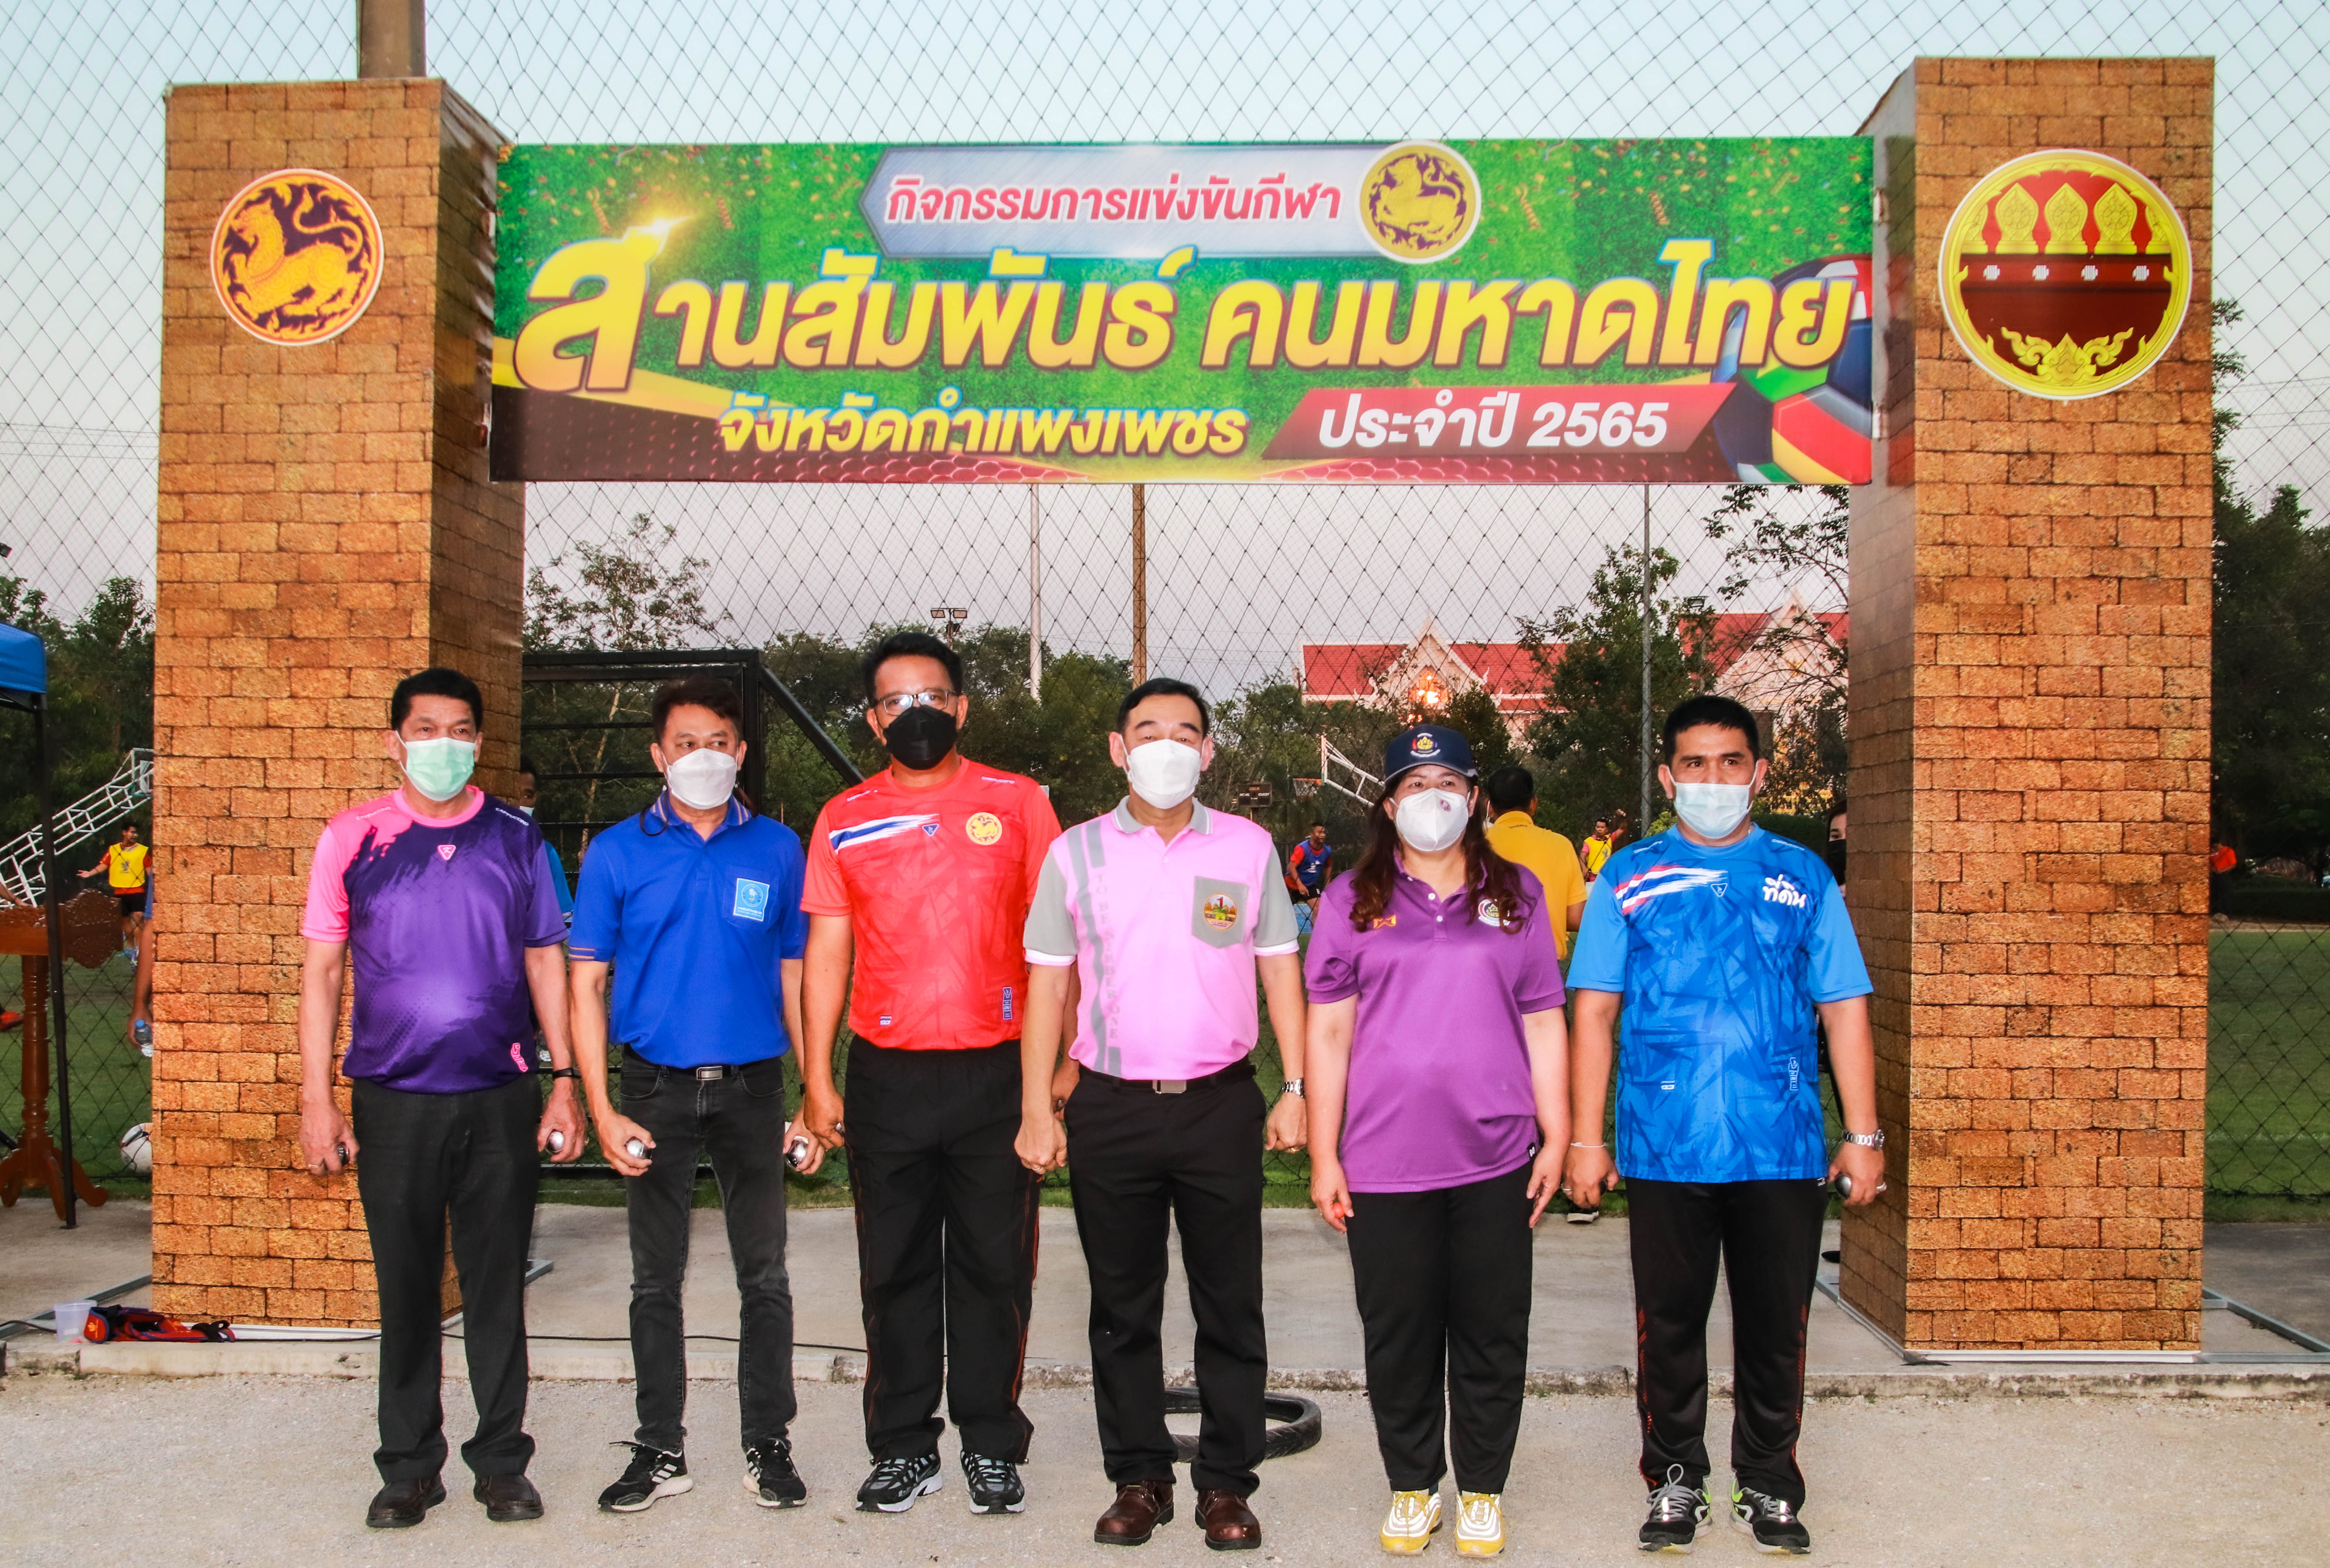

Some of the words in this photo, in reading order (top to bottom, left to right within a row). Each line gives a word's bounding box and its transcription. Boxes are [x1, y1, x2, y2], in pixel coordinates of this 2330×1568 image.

[886, 172, 1342, 221] กิจกรรมการแข่งขันกีฬา
[513, 226, 1197, 393] สานสัมพันธ์
[1200, 237, 1857, 371] คนมหาดไทย
[718, 386, 1251, 455] จังหวัดกำแพงเพชร
[1319, 388, 1521, 448] ประจำปี
[1526, 401, 1670, 447] 2565
[495, 807, 529, 826] CAPPUCCINO
[1096, 874, 1107, 893] TO
[1762, 873, 1807, 908] ที่ดิน
[1099, 902, 1110, 924] BE
